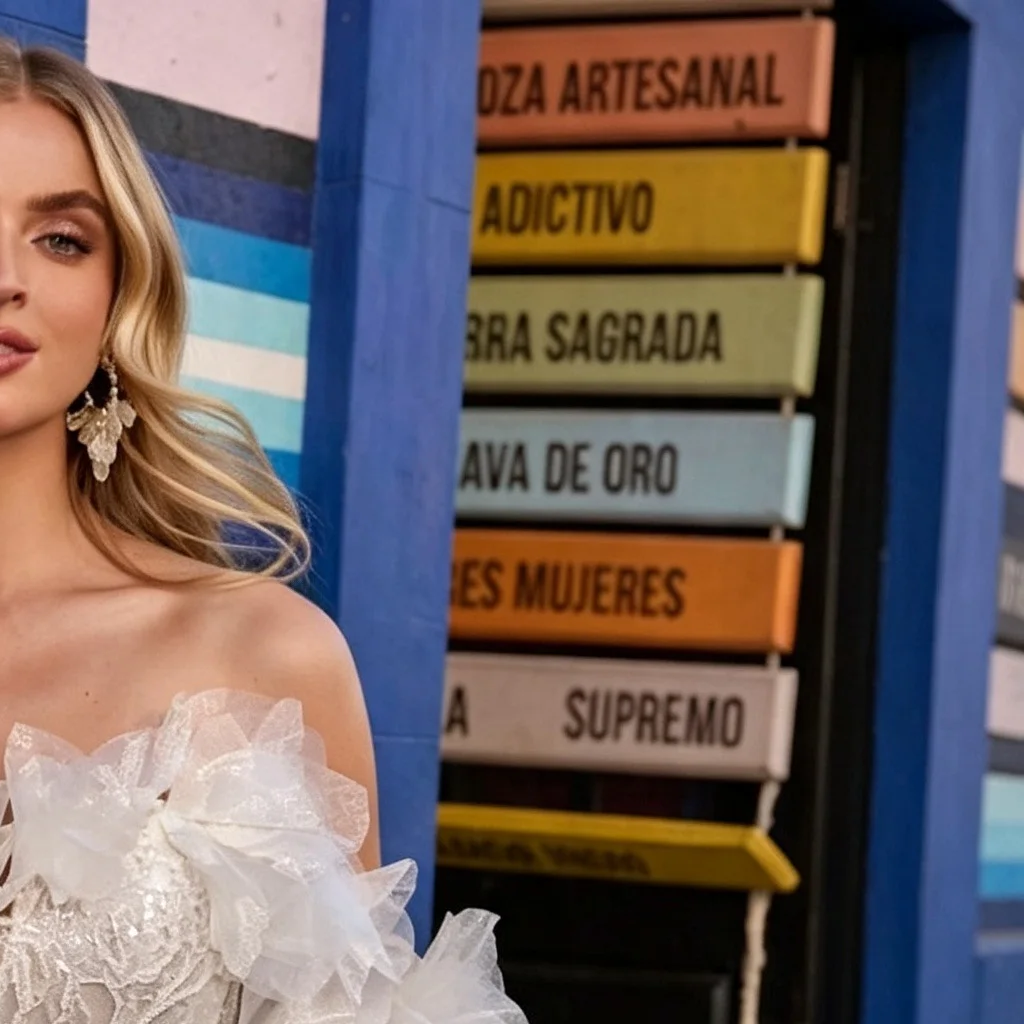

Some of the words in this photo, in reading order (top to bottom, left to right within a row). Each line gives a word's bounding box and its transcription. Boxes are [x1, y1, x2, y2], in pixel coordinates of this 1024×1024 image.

[558, 53, 784, 114] ARTESANAL
[480, 180, 655, 236] ADICTIVO
[545, 311, 724, 365] SAGRADA
[458, 440, 530, 493] AVA
[543, 441, 591, 495] DE
[601, 443, 679, 498] ORO
[512, 559, 687, 619] MUJERES
[443, 684, 470, 738] A
[562, 686, 745, 750] SUPREMO
